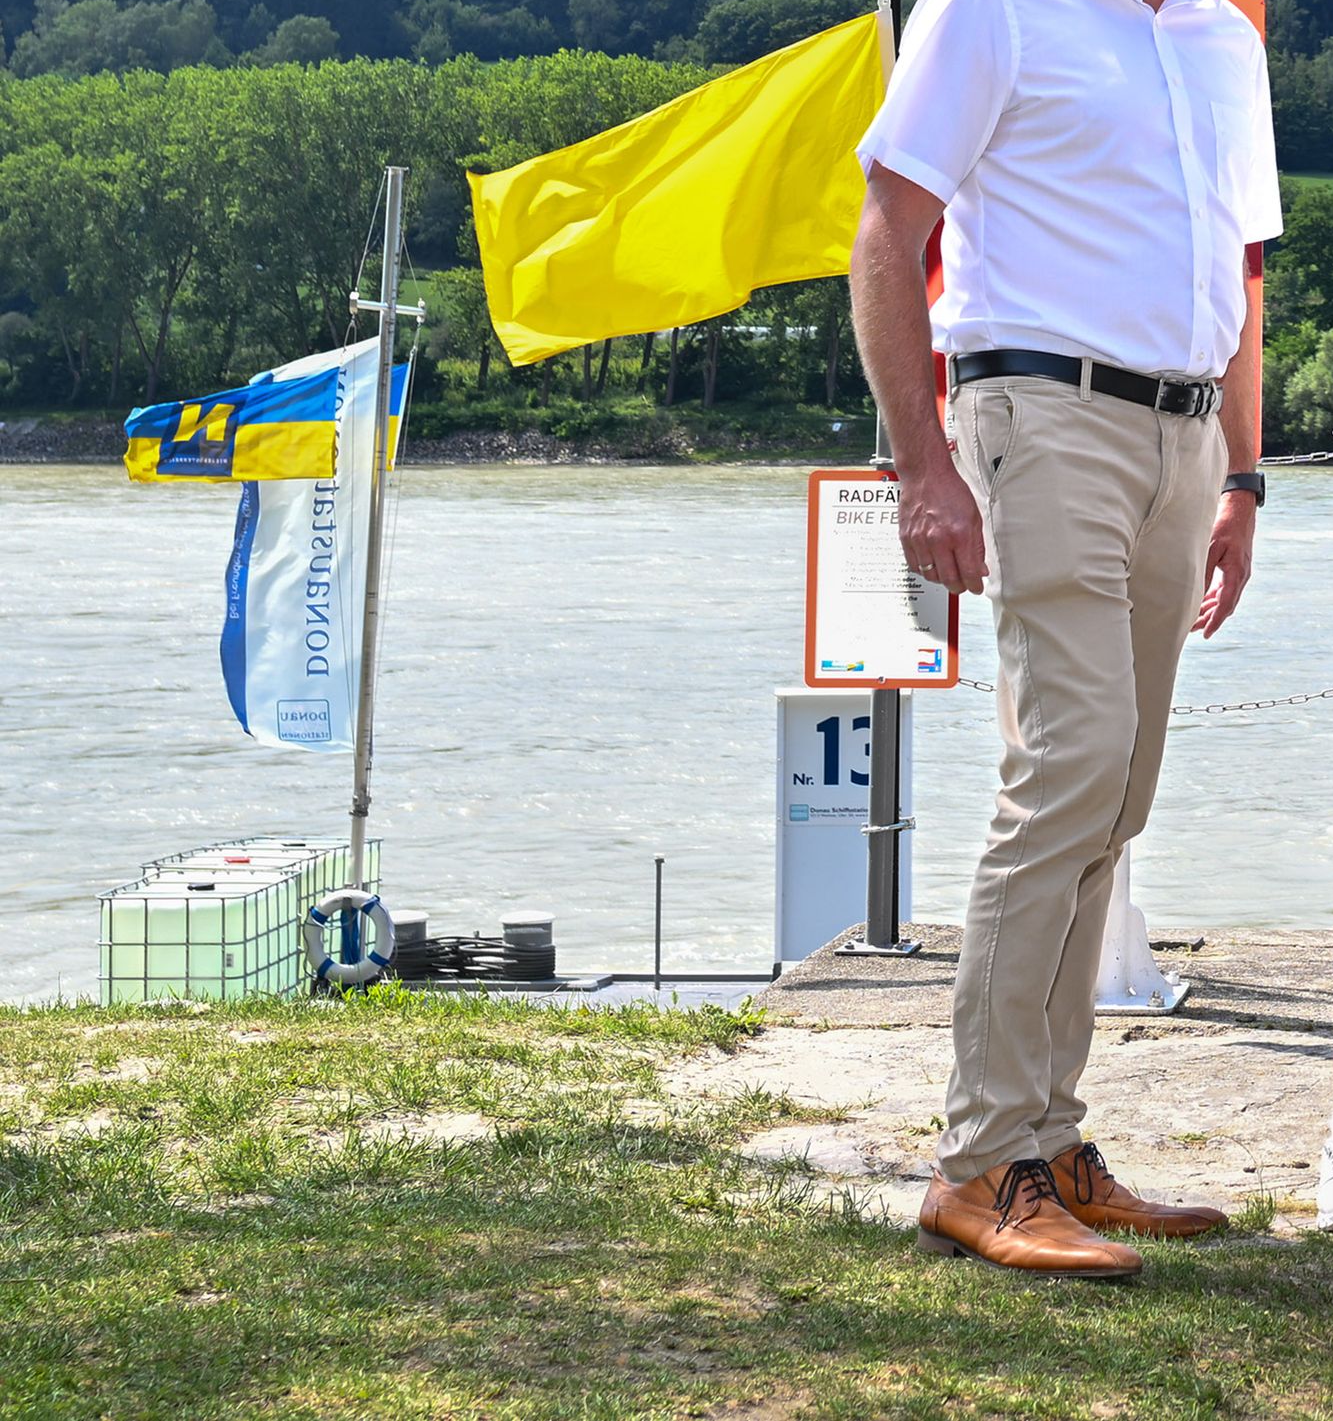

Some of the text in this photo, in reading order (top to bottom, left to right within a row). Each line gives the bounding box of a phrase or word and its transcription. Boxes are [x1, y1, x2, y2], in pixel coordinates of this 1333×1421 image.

[839, 486, 901, 503] RADFÄ
[837, 511, 875, 524] BIKE
[793, 773, 815, 785] Nr.
